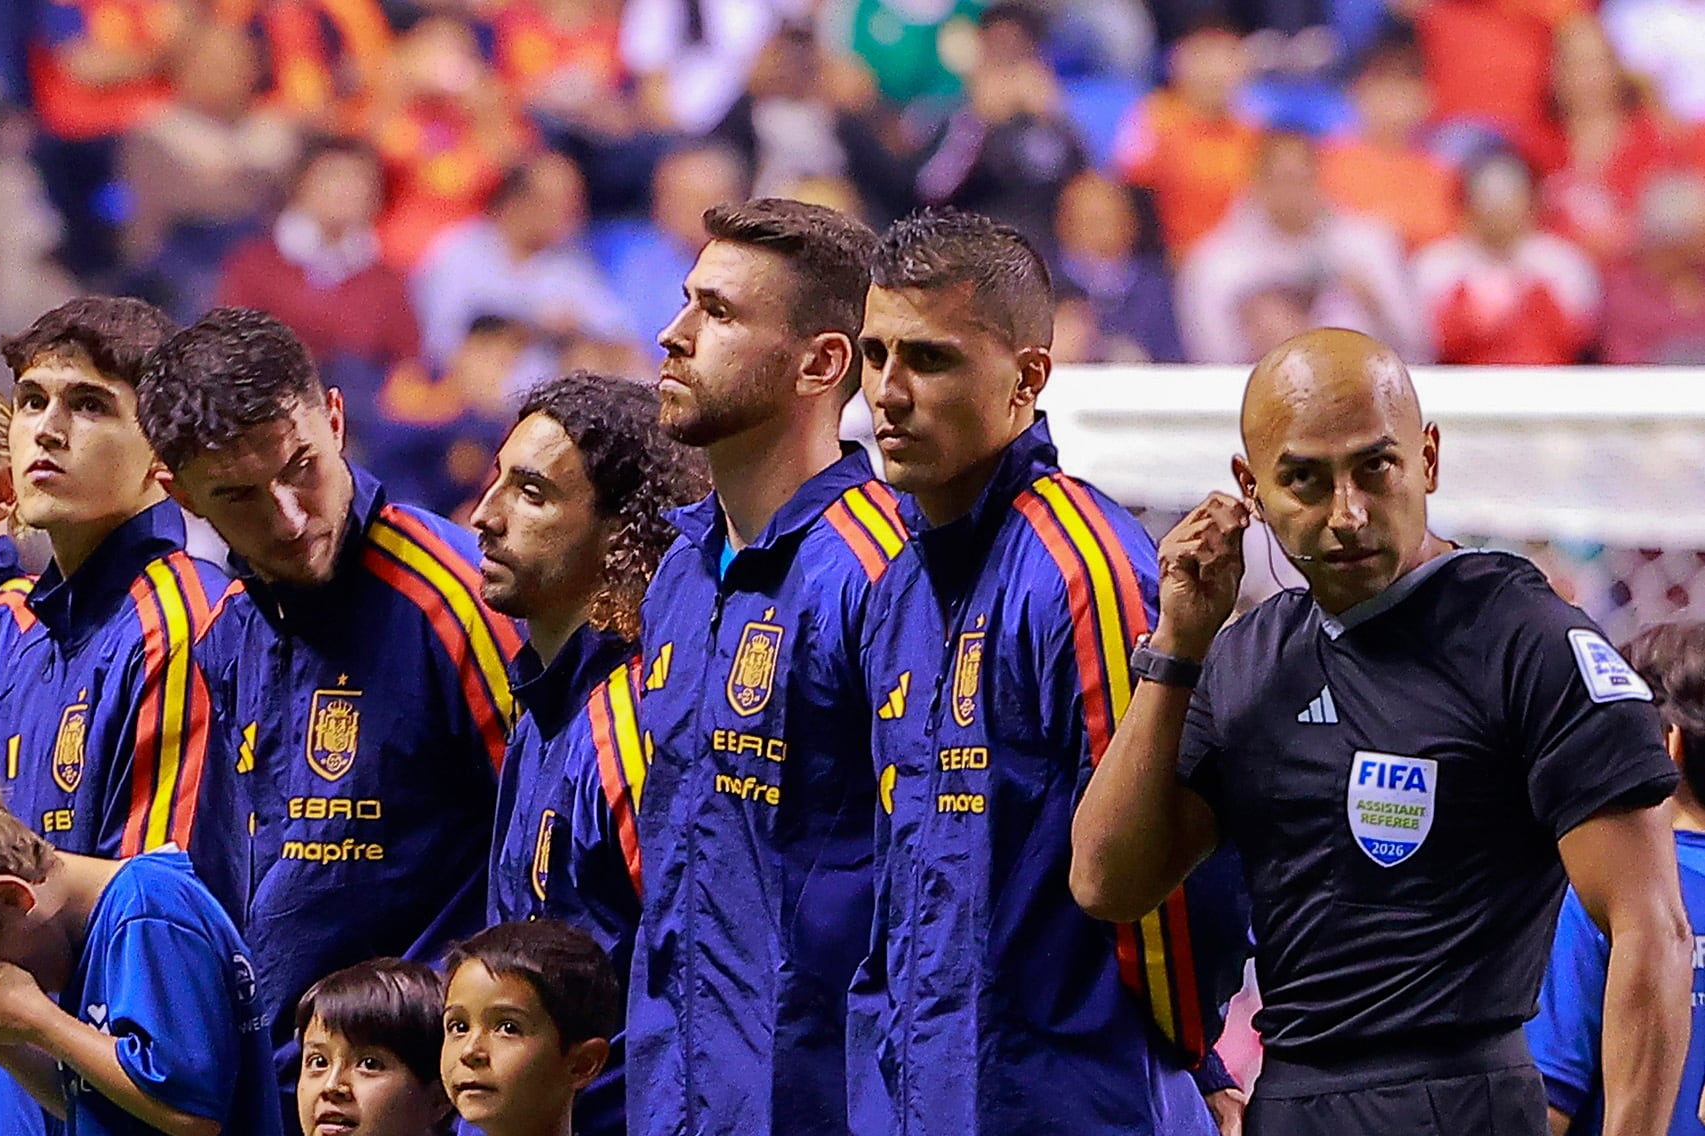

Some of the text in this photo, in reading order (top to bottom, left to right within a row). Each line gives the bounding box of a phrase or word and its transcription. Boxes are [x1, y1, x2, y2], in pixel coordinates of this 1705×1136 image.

[1358, 761, 1427, 793] FIFA
[1357, 800, 1426, 817] ASSISTANT
[43, 809, 75, 832] EB
[1360, 813, 1420, 830] REFEREE
[282, 838, 384, 865] mapfre
[1371, 841, 1404, 857] 2026
